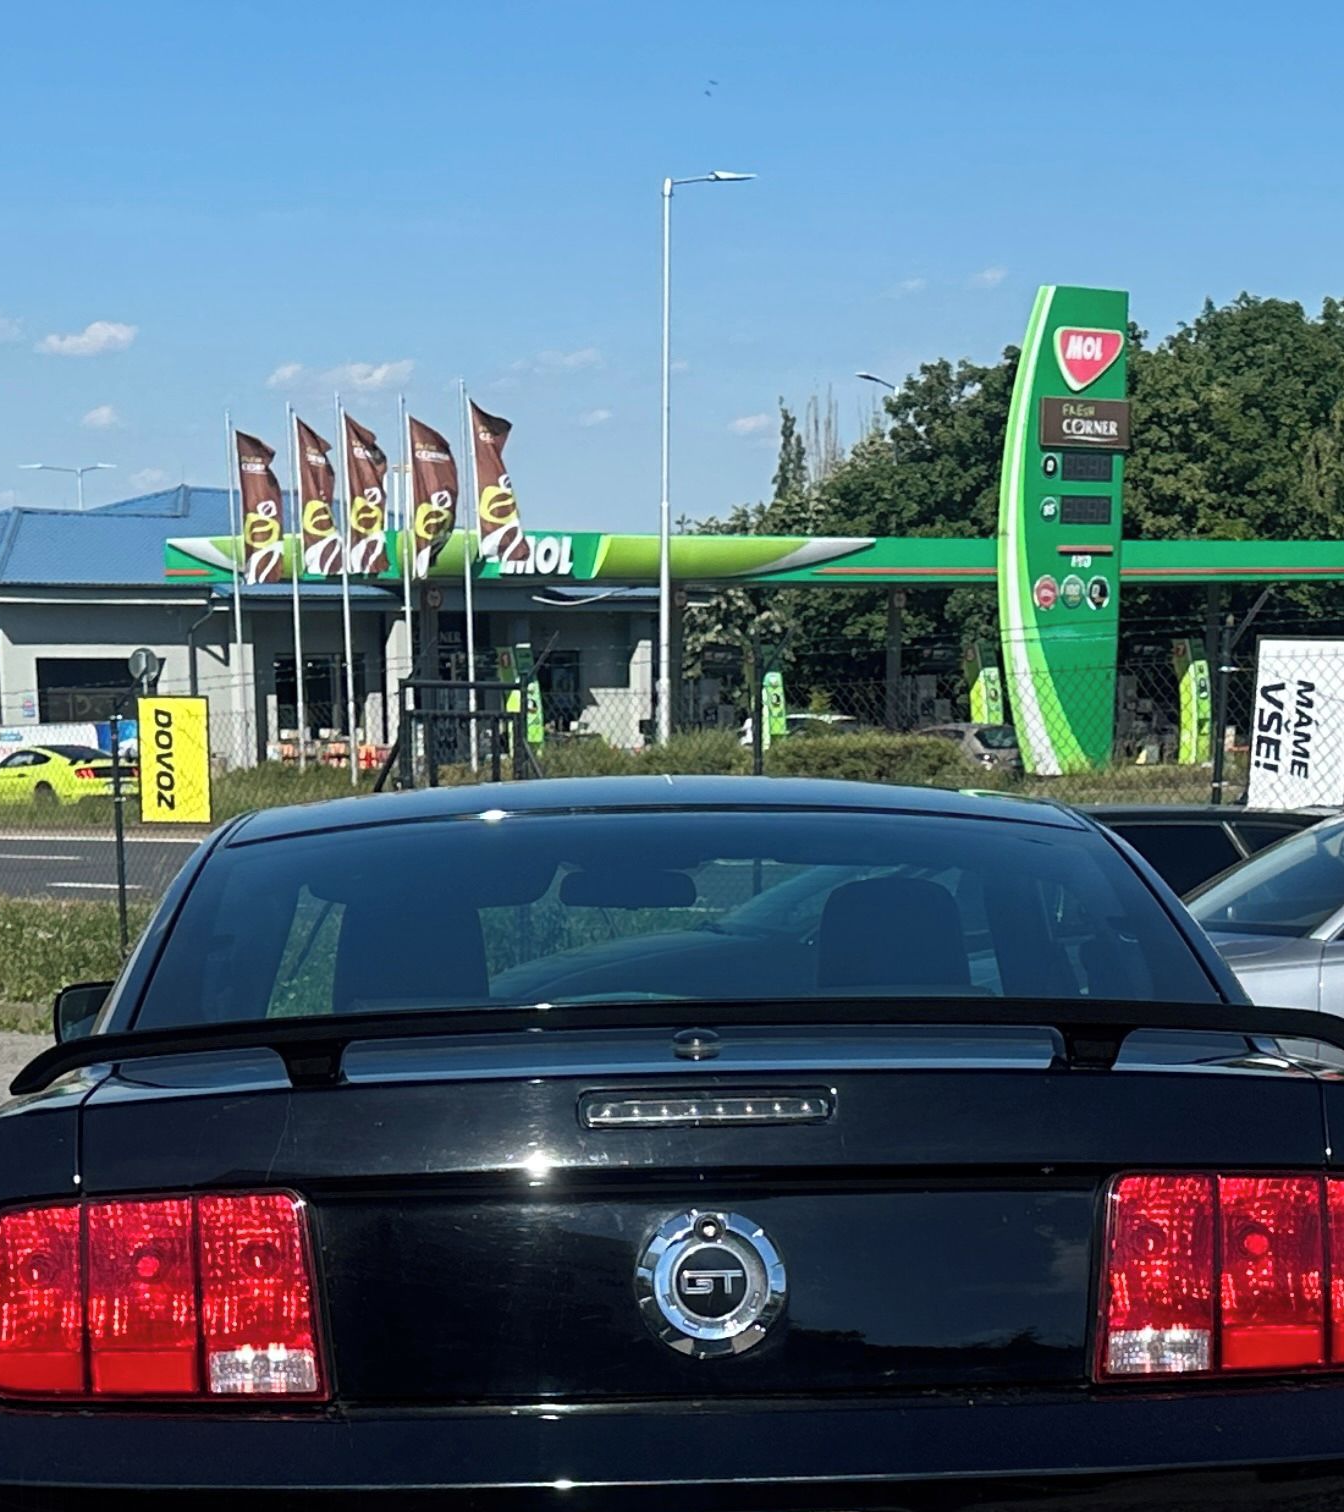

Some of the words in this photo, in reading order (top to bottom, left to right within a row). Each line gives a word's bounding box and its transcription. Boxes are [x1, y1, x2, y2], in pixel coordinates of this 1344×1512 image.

[1065, 335, 1103, 360] MOL
[1062, 404, 1096, 417] FRESH
[1062, 418, 1118, 436] CORNER
[1254, 683, 1291, 773] VŠE!
[1290, 680, 1319, 779] MÁME
[154, 709, 176, 811] DOVOZ
[680, 1269, 744, 1295] GT
